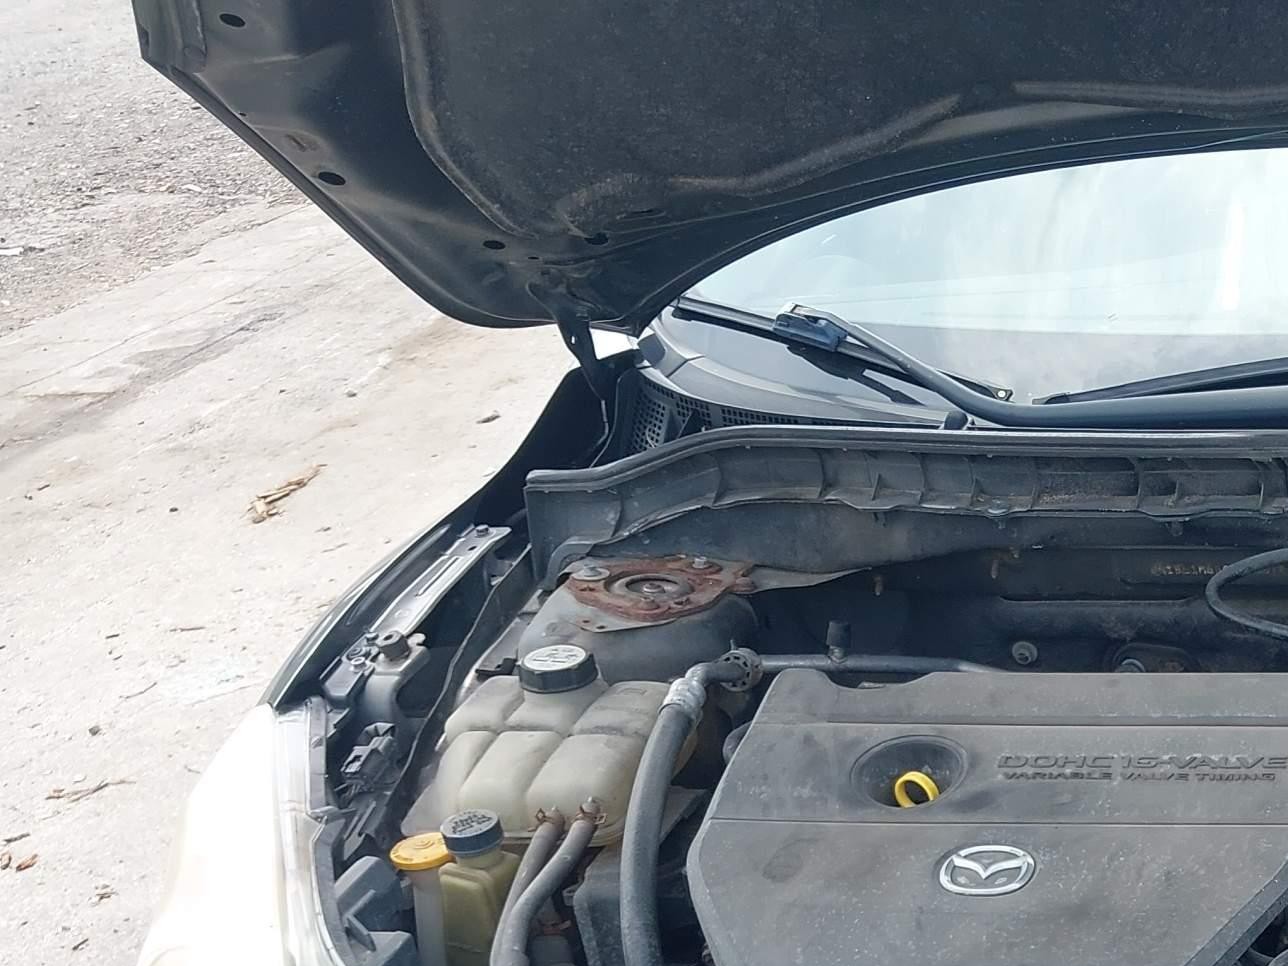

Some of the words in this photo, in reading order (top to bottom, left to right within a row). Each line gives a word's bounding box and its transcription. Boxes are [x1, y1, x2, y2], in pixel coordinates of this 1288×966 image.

[997, 755, 1115, 770] DOHC
[1122, 755, 1288, 770] 16-VALVE
[1003, 771, 1113, 782] VARIABLE
[1120, 771, 1190, 782] VALVE
[1195, 772, 1277, 783] TIMING
